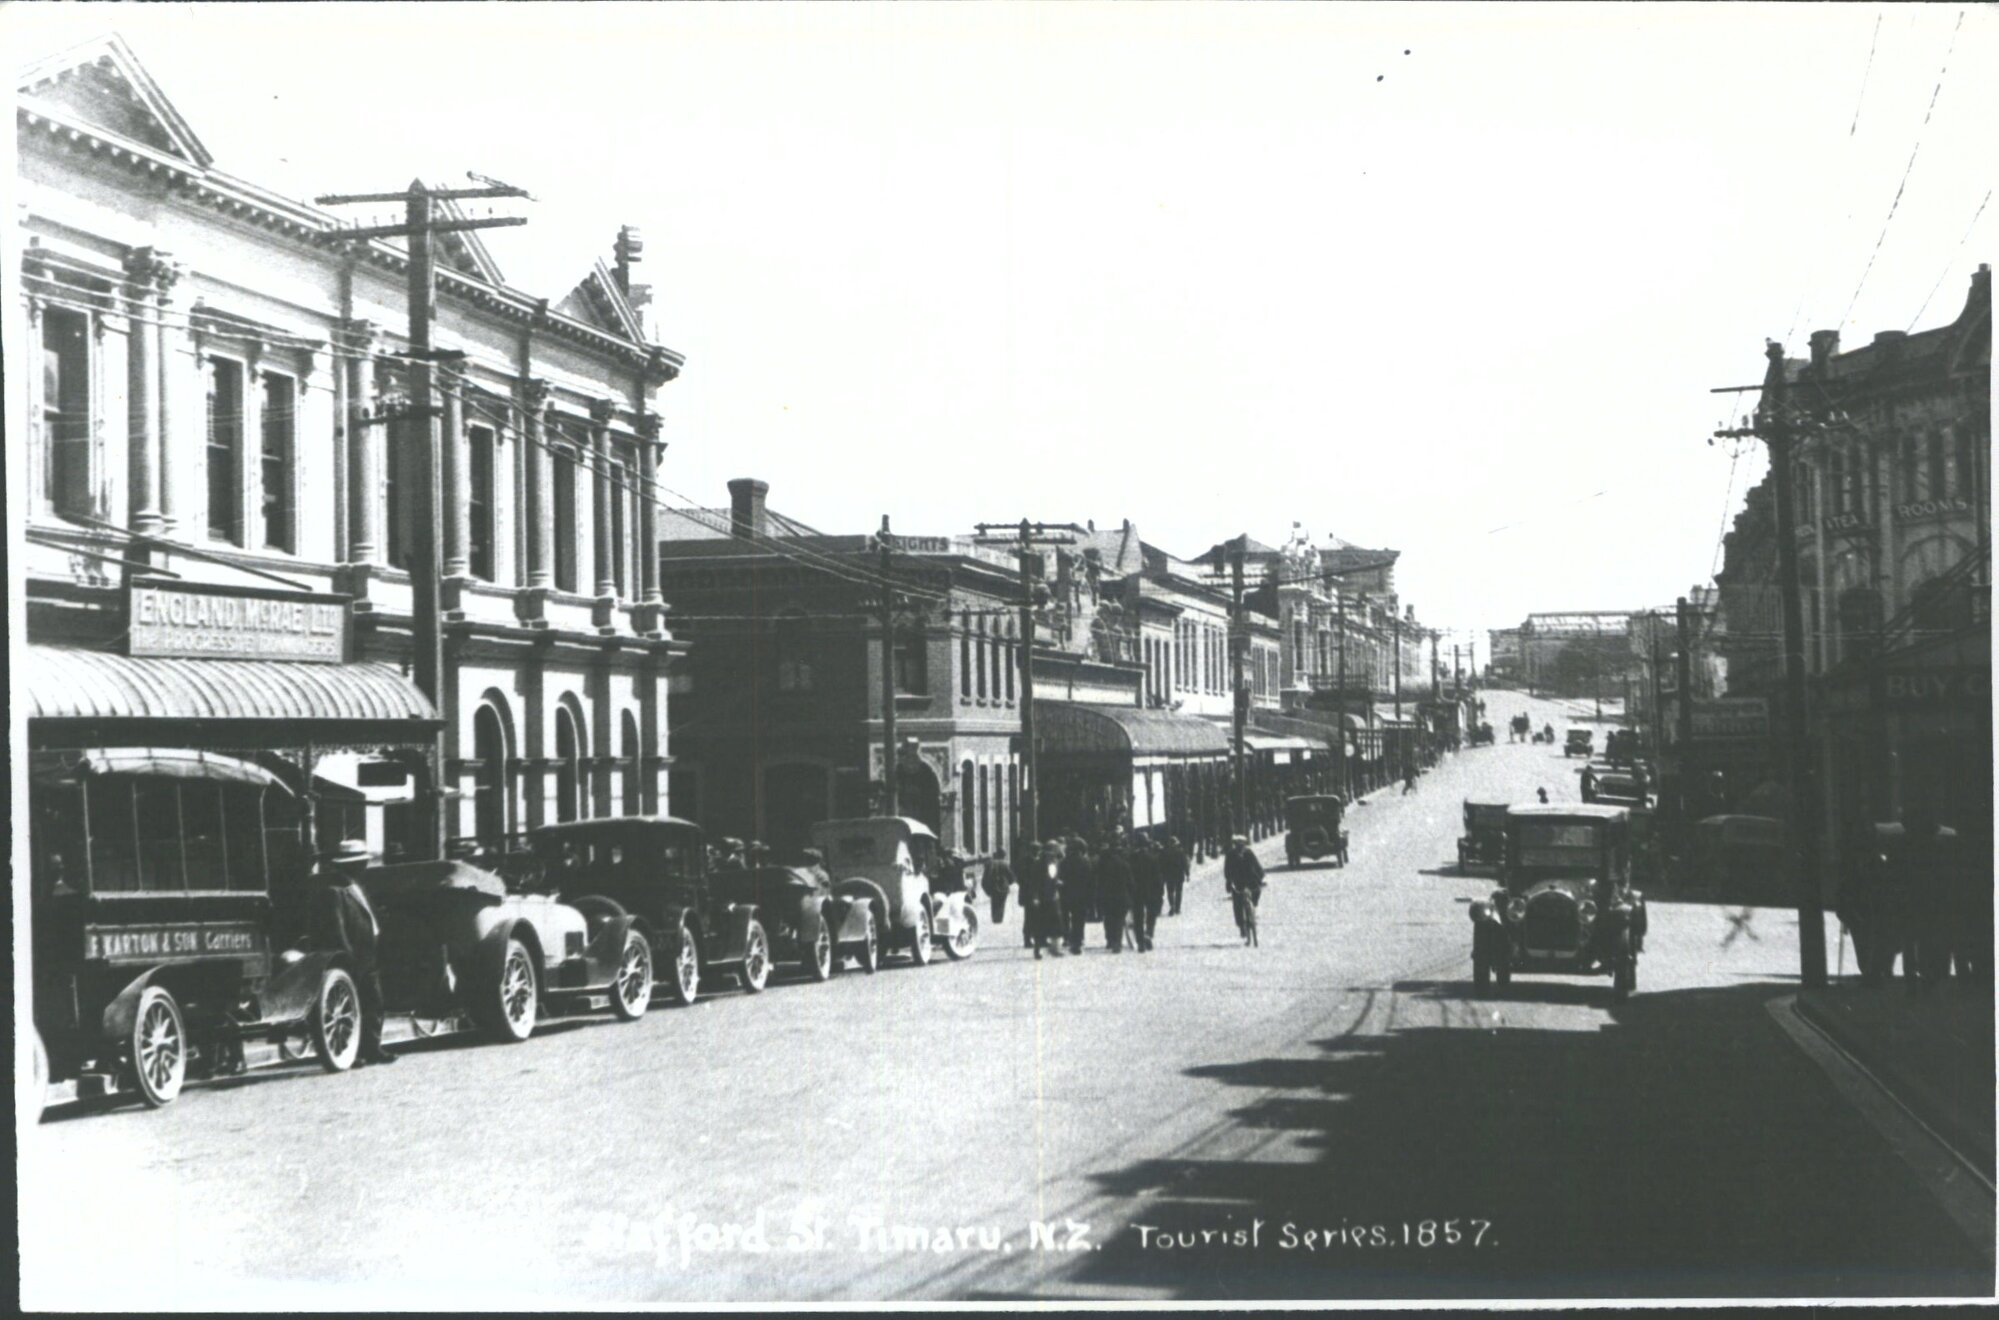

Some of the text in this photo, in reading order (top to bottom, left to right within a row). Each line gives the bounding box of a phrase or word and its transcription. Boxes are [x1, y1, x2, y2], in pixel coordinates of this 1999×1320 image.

[1897, 497, 1968, 519] ROOMS
[1886, 674, 1953, 698] BUY
[163, 932, 171, 952] &
[174, 931, 197, 952] SON
[205, 930, 252, 951] Carriers
